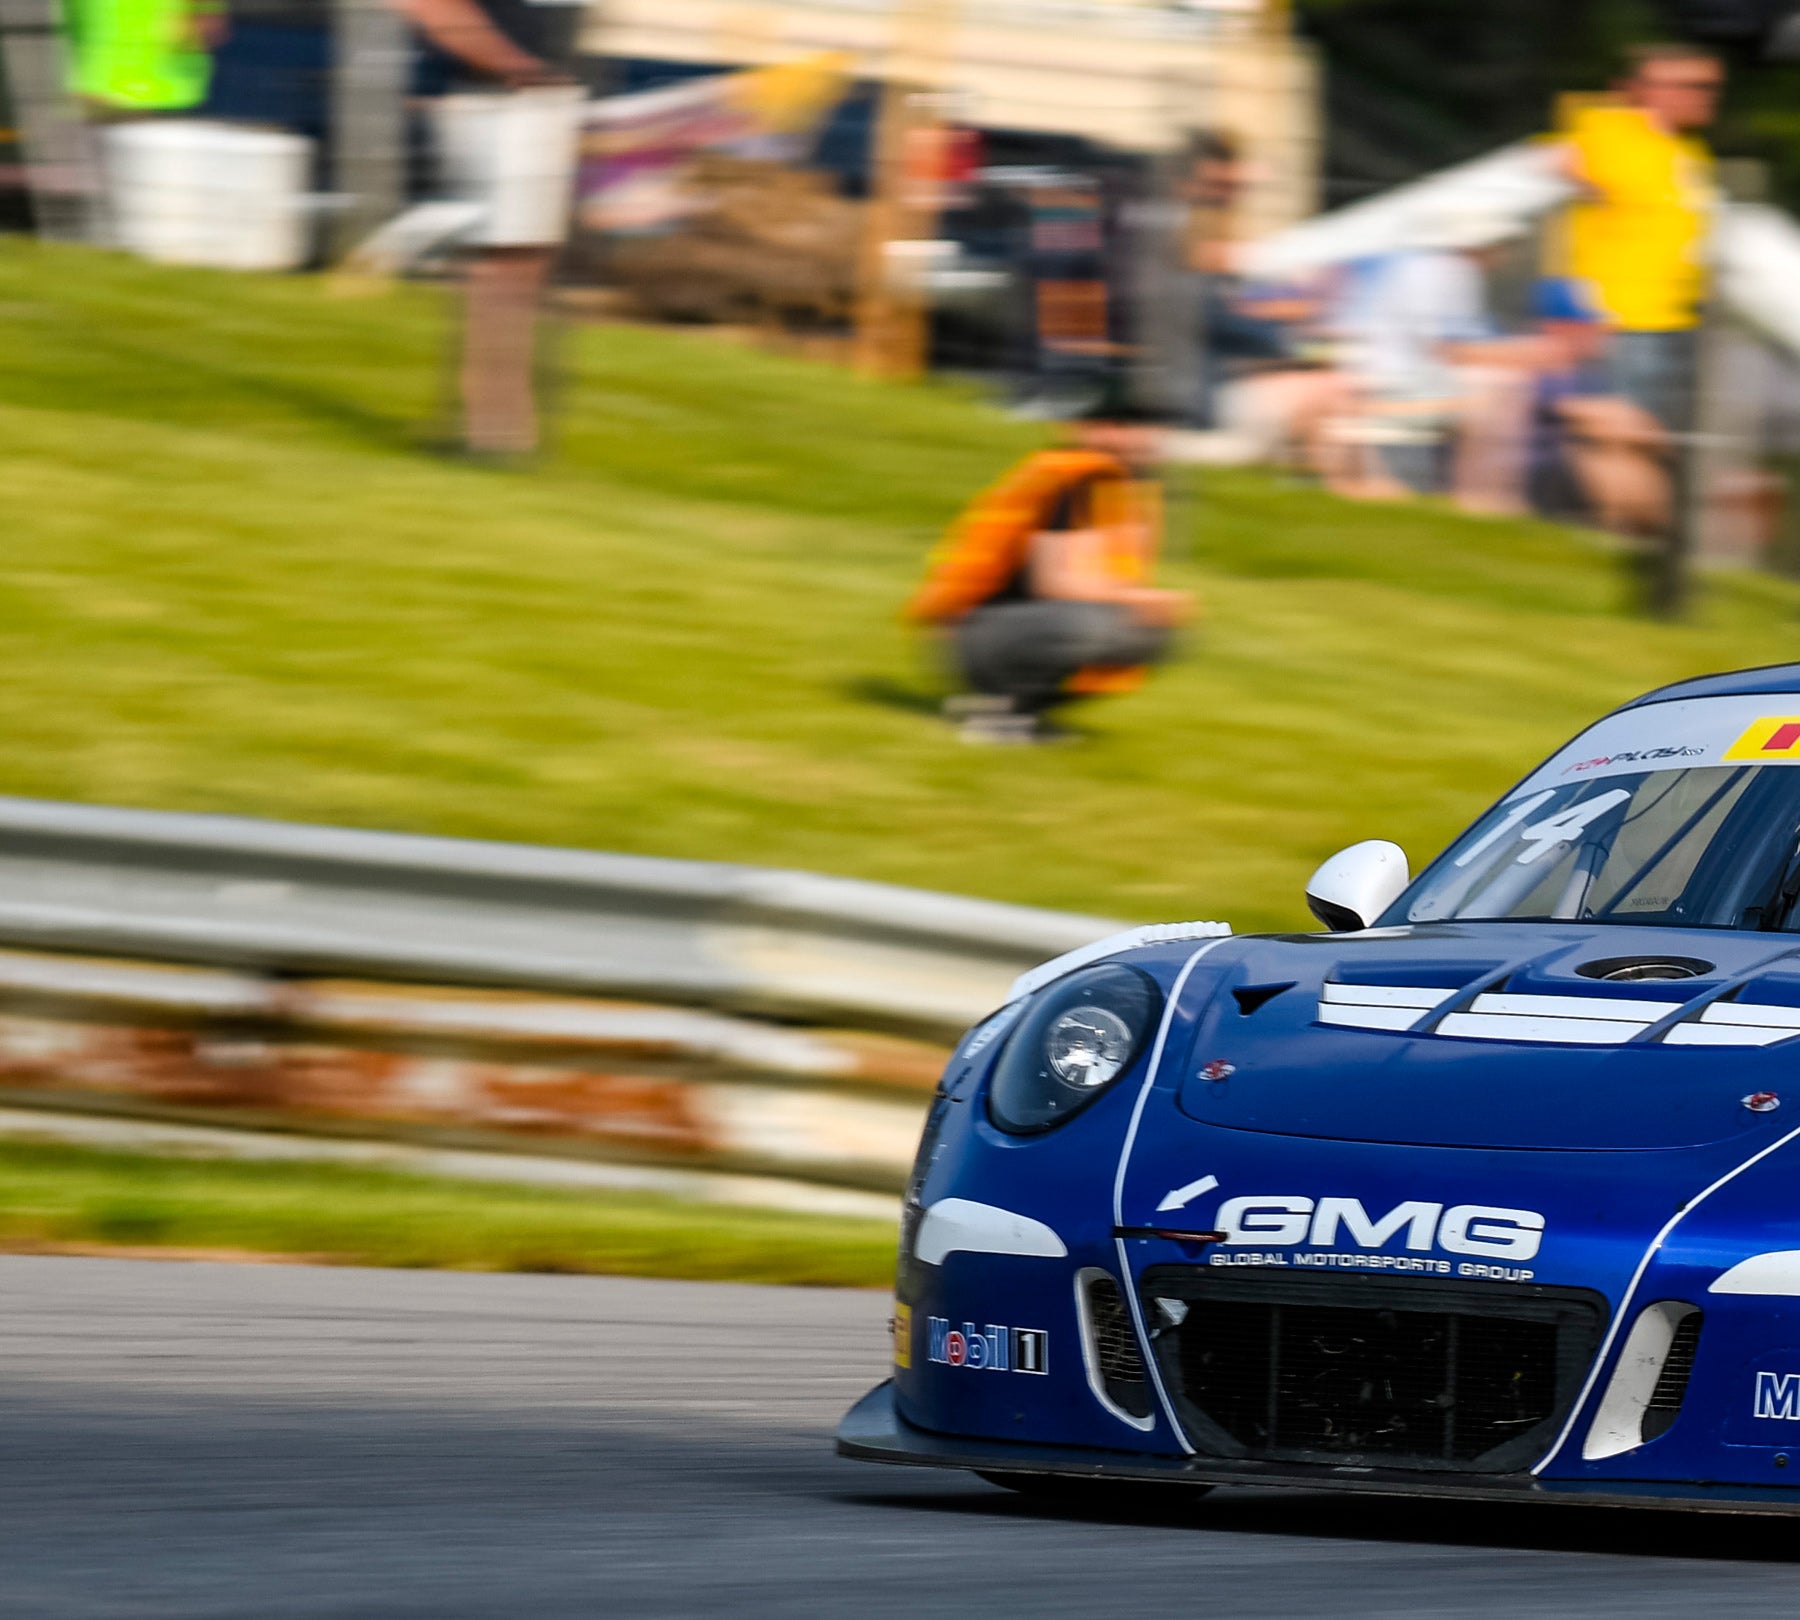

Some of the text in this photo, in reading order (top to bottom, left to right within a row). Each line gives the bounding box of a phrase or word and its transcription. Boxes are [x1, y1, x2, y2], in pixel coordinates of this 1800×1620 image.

[1454, 789, 1631, 867] 14
[1214, 1195, 1546, 1261] GMG
[1210, 1252, 1535, 1282] GLOBAL MOTORSPORTS GROUP
[927, 1315, 1009, 1371] Mobil
